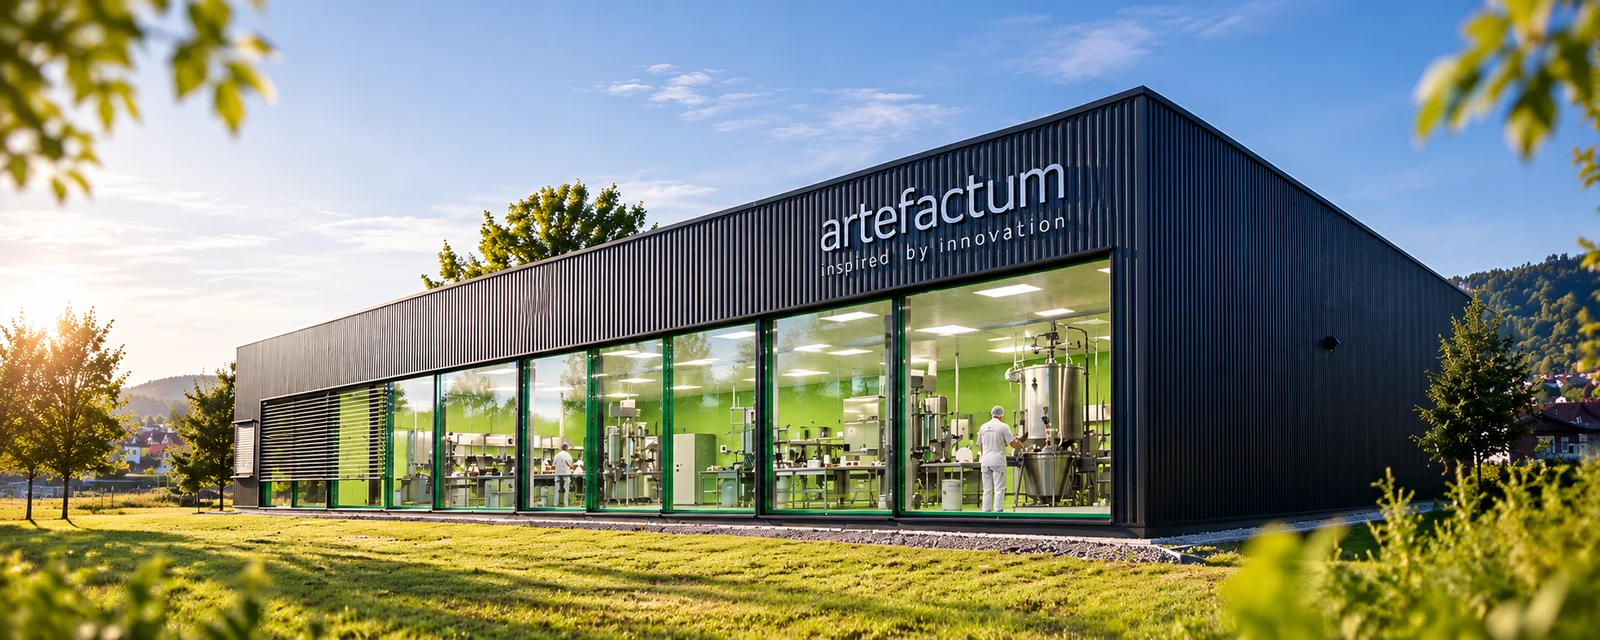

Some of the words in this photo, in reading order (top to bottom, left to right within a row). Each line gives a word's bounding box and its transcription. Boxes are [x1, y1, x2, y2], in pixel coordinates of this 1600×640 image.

[820, 163, 1065, 252] artefactum
[821, 248, 889, 277] inspired
[906, 244, 928, 262] by
[940, 215, 1065, 253] innovation
